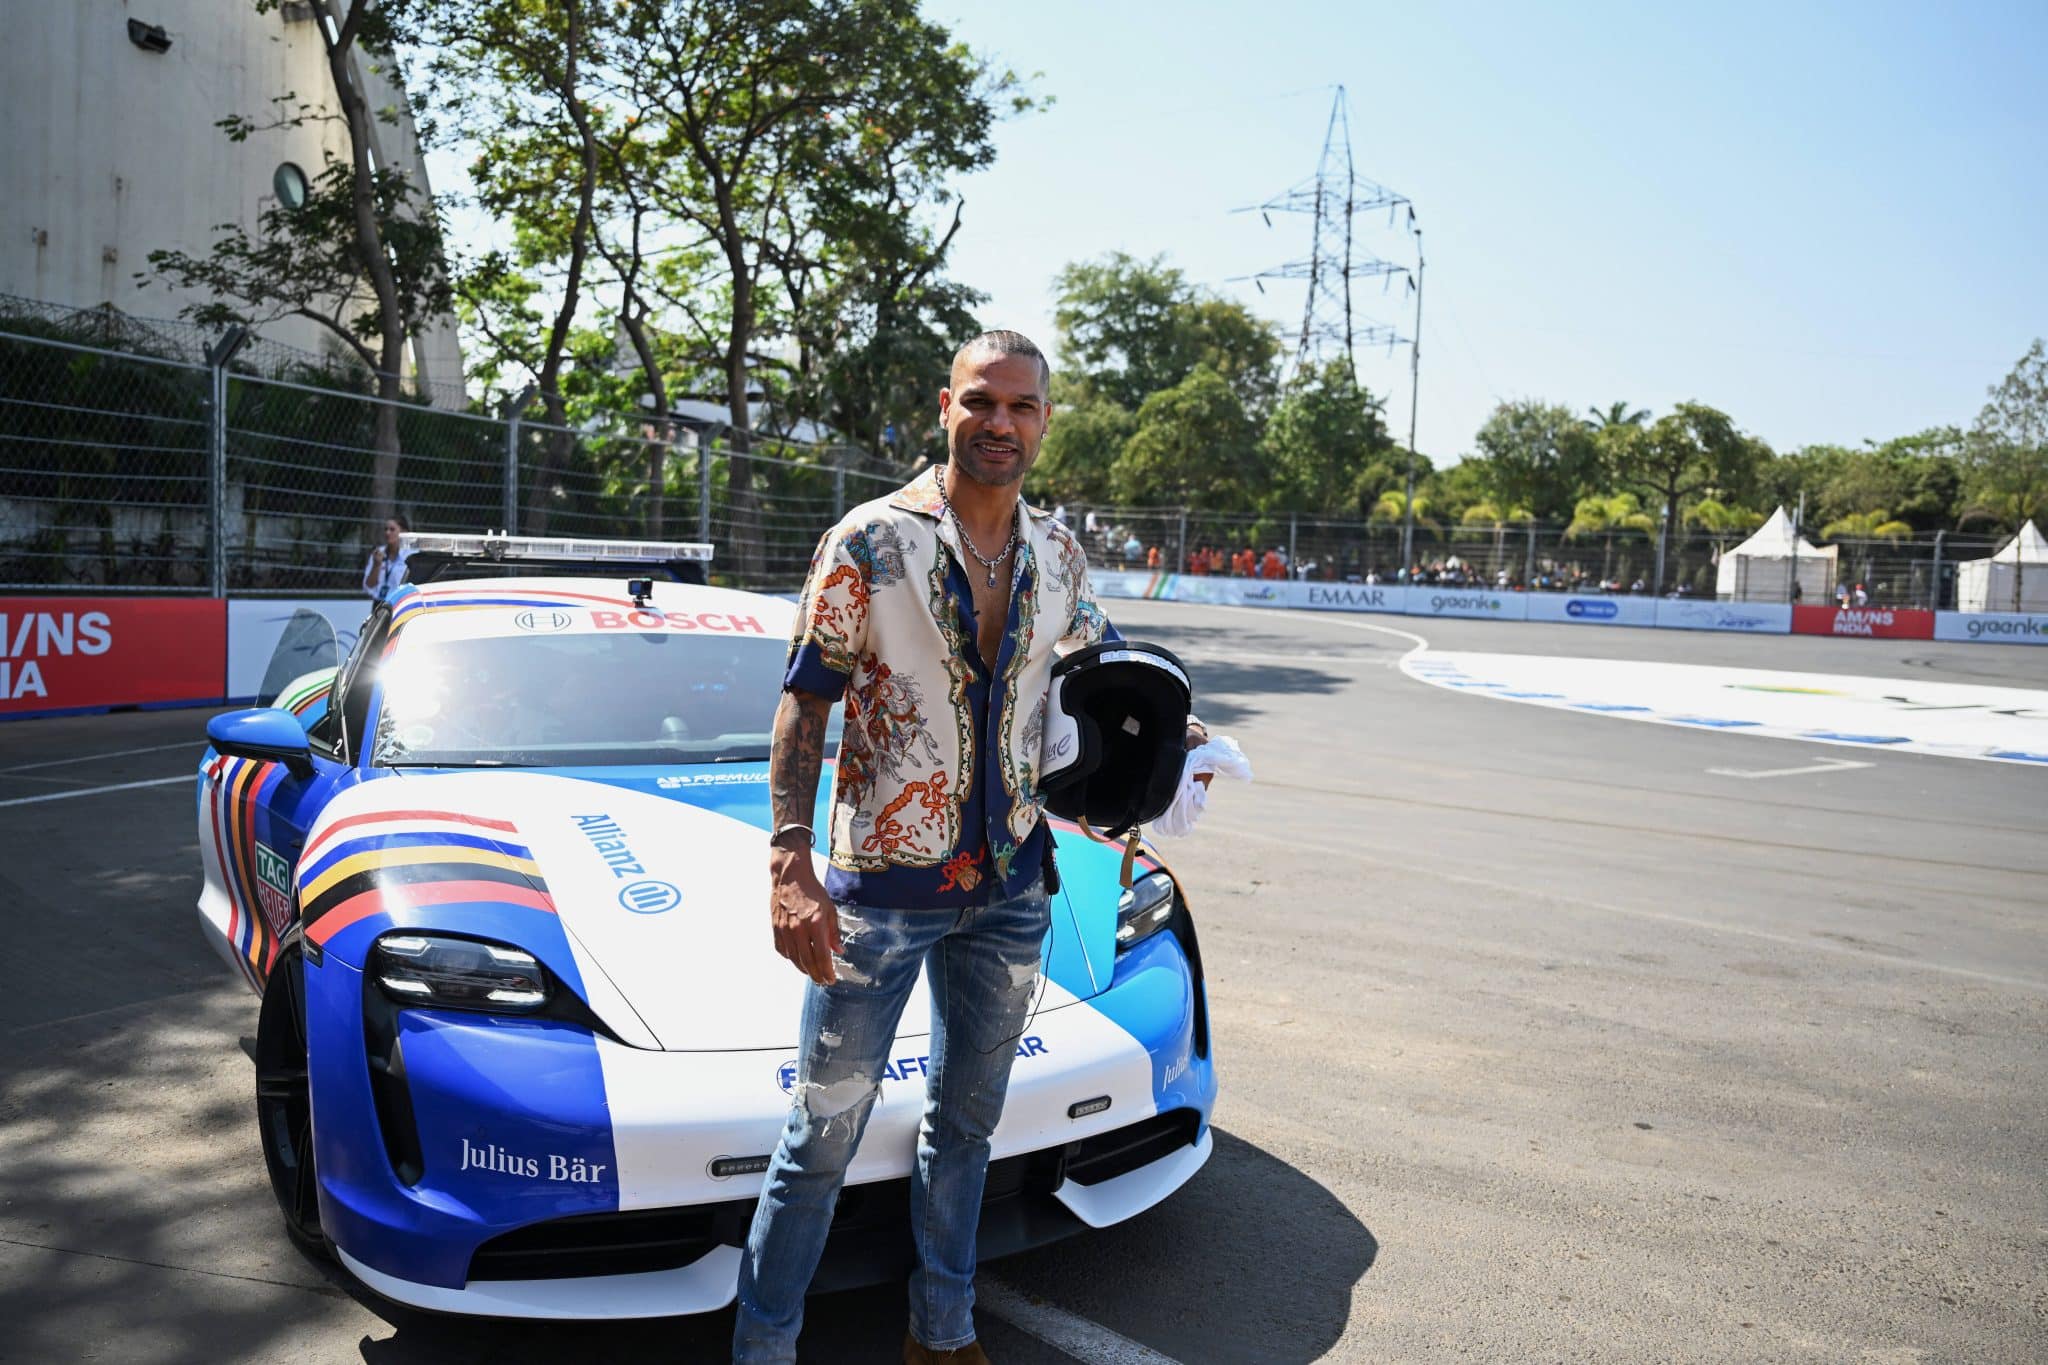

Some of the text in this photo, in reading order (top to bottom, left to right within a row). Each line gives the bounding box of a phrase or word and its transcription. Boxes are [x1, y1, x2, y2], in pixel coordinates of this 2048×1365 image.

[1309, 587, 1384, 606] EMAAR
[0, 611, 112, 657] /NS
[591, 611, 765, 633] BOSCH
[1834, 610, 1893, 626] AM/NS
[1834, 623, 1872, 635] INDIA
[333, 738, 343, 756] 2
[571, 814, 645, 878] Allianz
[258, 849, 287, 891] TAG
[259, 881, 290, 930] HEUER
[461, 1139, 606, 1183] Julius Bär
